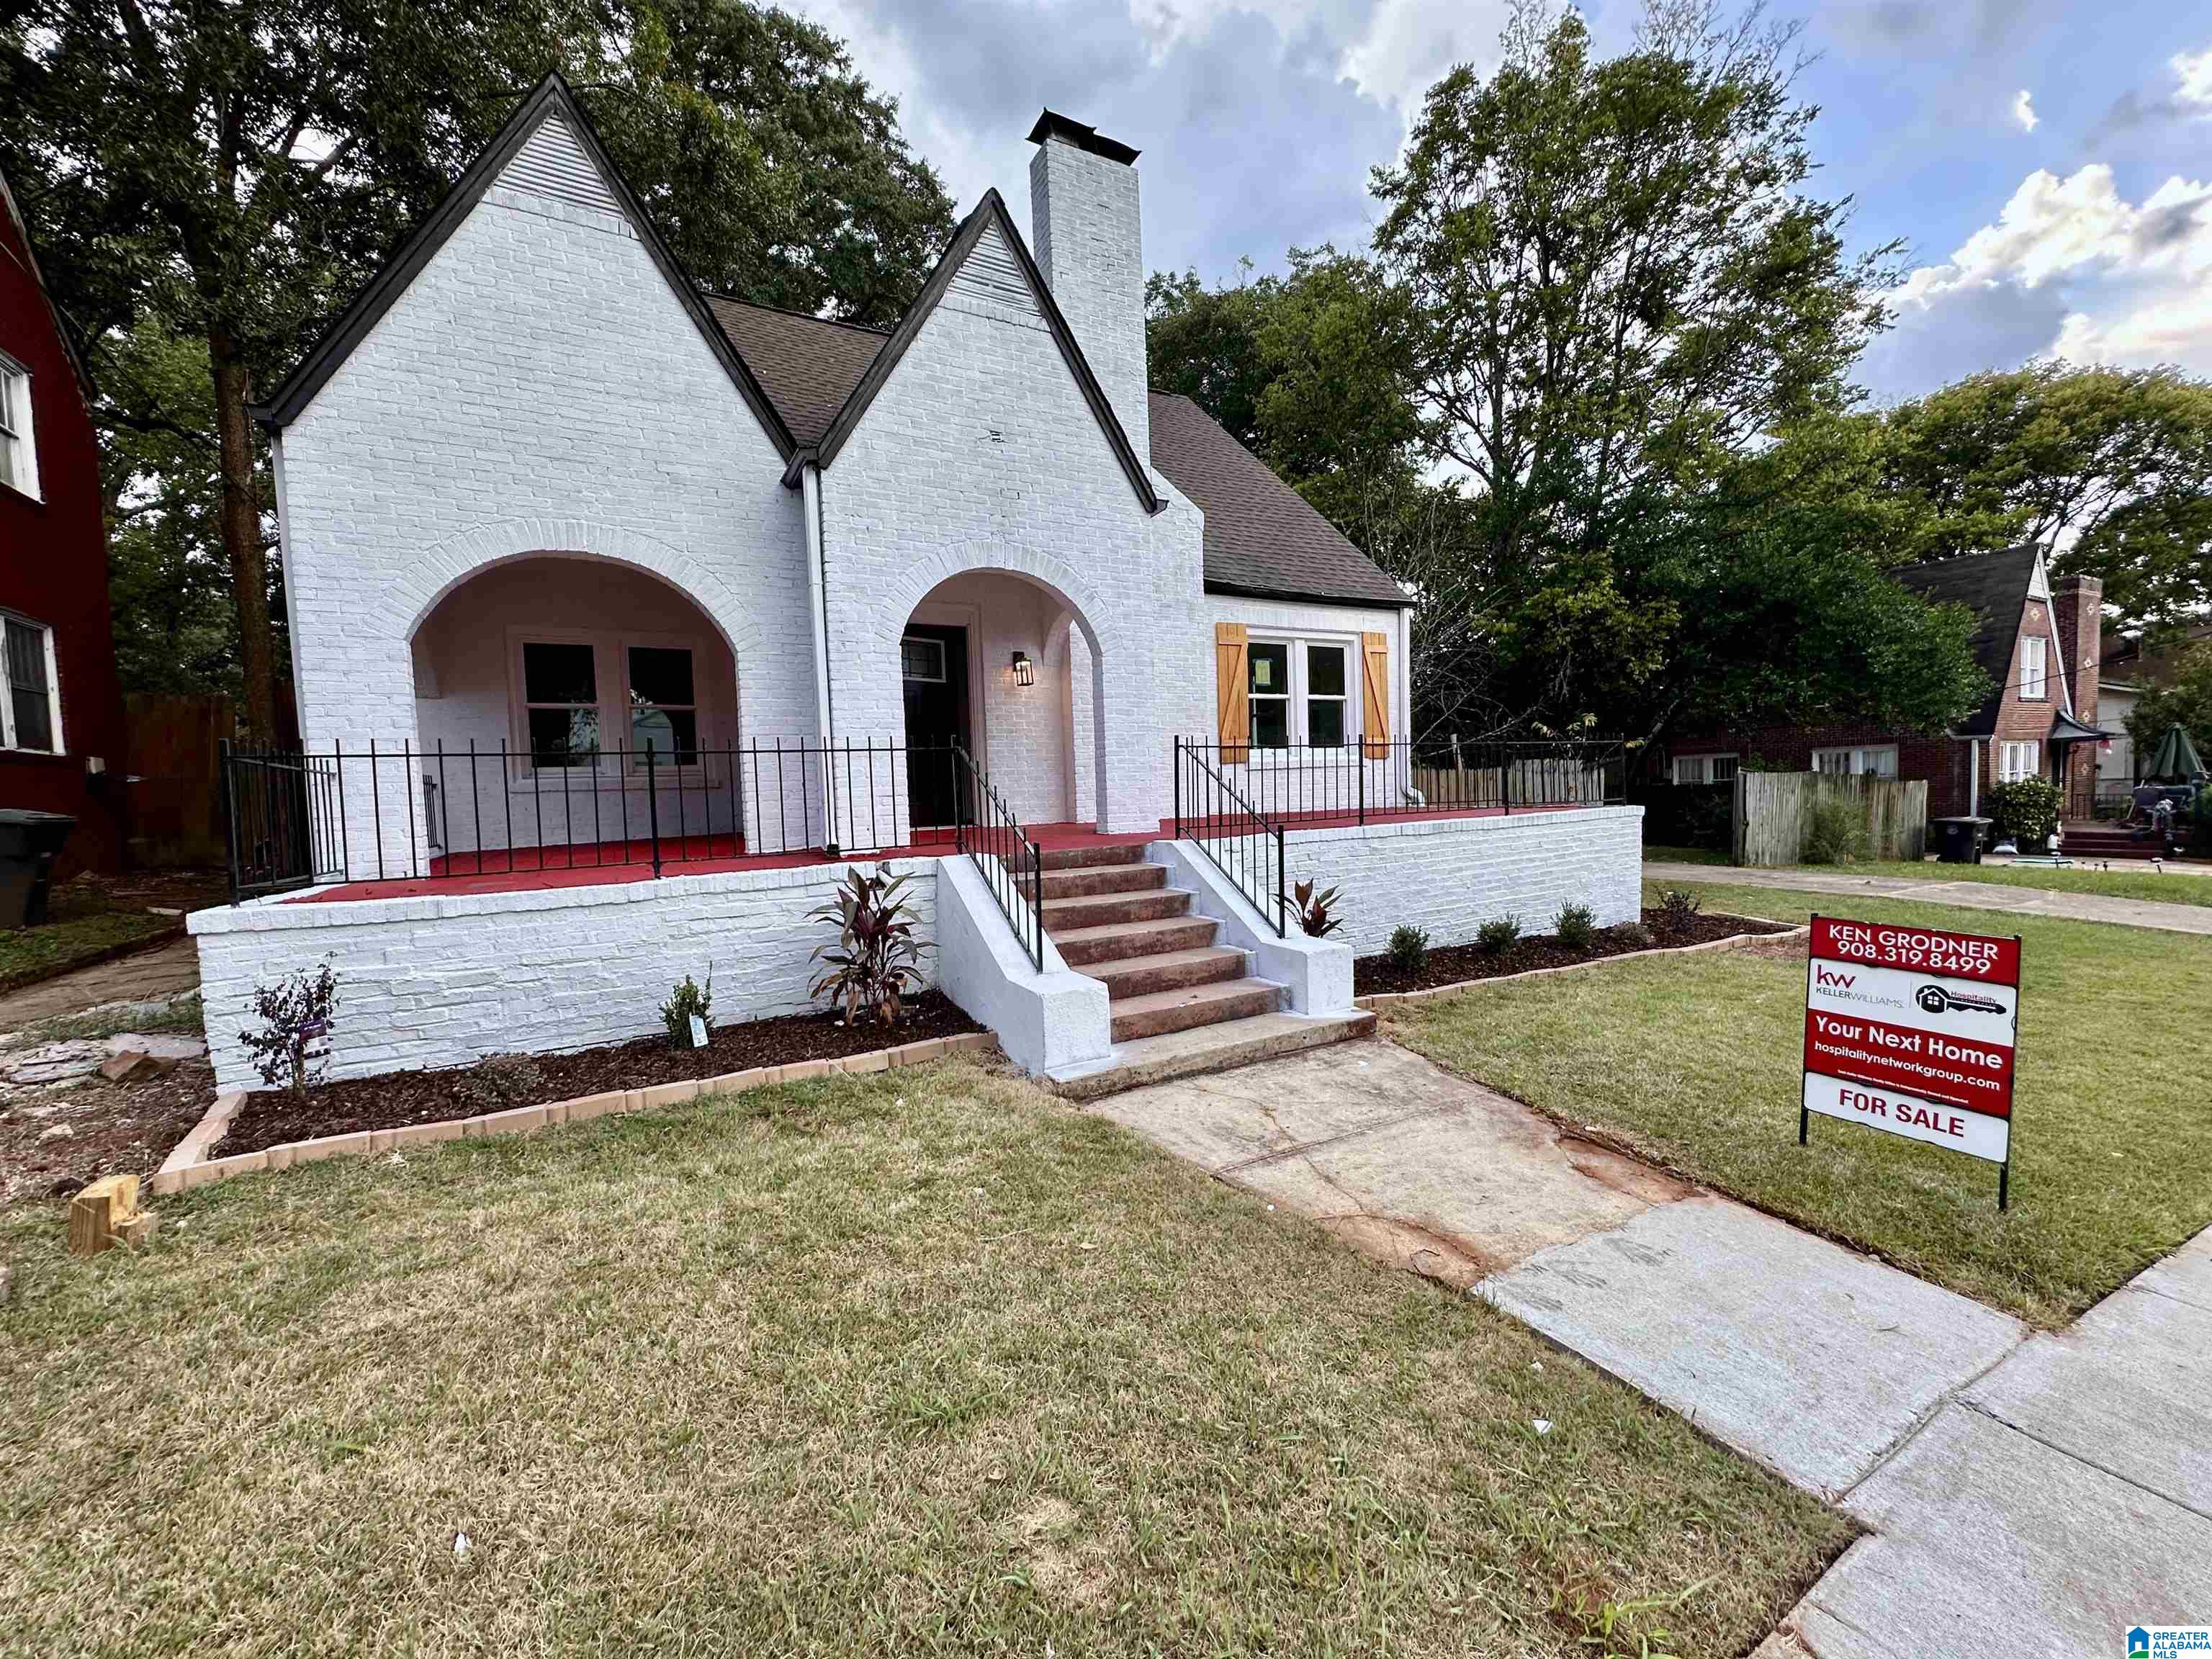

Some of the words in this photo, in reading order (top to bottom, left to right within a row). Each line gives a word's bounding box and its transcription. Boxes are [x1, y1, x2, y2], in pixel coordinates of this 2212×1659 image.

[1829, 925, 1871, 943] KEN
[1878, 930, 1999, 960] GRODNER
[1838, 940, 1991, 974] 908.319.8499
[1817, 964, 1856, 988] kw
[1951, 991, 1997, 1003] Hospitality
[1815, 1015, 1862, 1040] Your
[1869, 1025, 1921, 1052] Next
[1928, 1038, 2003, 1069] Home
[1815, 1040, 2000, 1090] hospitalitynetworkgroup.com
[1840, 1089, 1887, 1117] FOR
[1895, 1104, 1965, 1137] SALE
